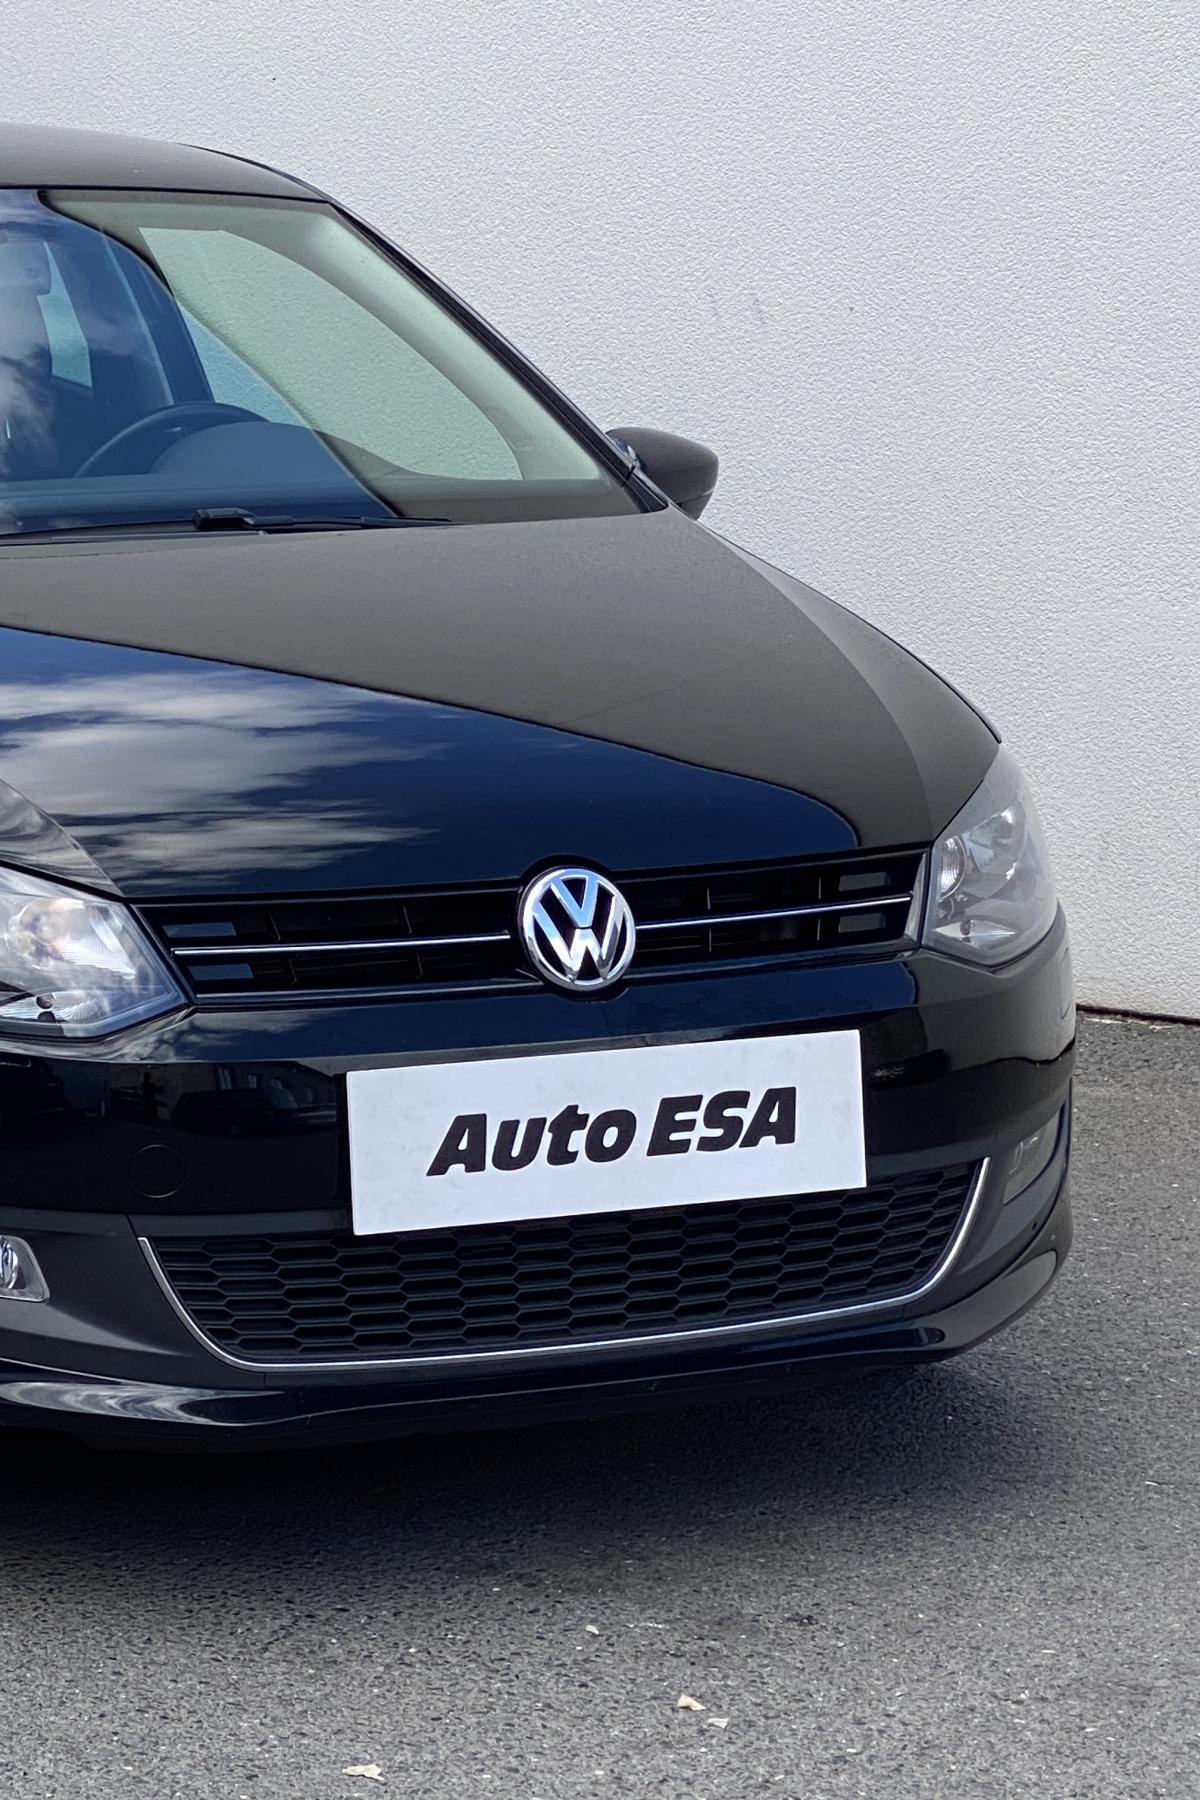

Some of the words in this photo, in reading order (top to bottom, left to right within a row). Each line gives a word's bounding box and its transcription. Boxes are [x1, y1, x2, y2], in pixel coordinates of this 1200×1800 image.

[520, 866, 636, 991] VW
[426, 1105, 637, 1177] Auto
[646, 1086, 797, 1157] ESA
